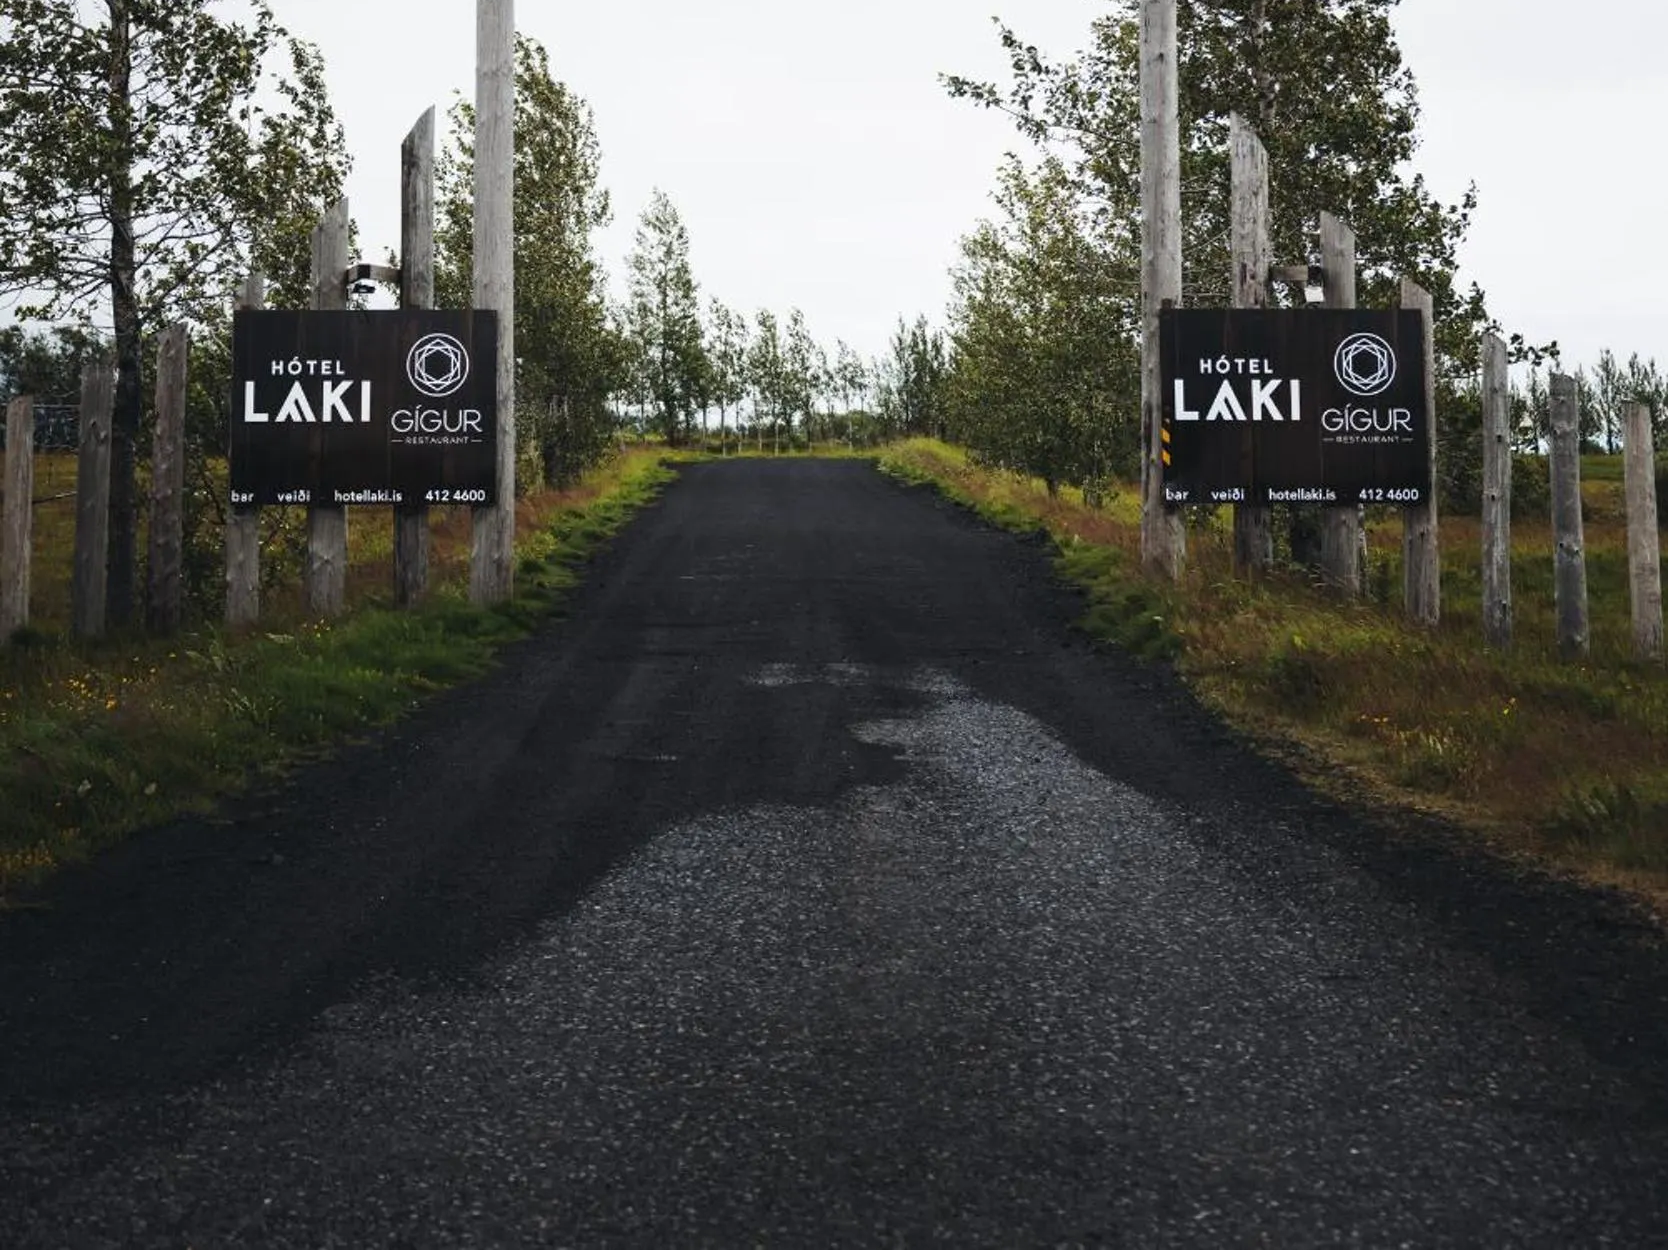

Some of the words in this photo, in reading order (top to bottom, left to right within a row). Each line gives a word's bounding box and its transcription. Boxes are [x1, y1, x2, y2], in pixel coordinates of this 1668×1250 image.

[271, 356, 346, 375] HÓTEL
[1199, 354, 1274, 374] HÓTEL
[244, 380, 371, 423] LAKI
[1174, 379, 1301, 421] LAKI
[391, 404, 483, 433] GÍGUR
[1321, 403, 1413, 432] GÍGUR
[405, 436, 470, 445] RESTAURANT
[1335, 435, 1400, 444] RESTAURANT
[231, 490, 254, 502] bar
[277, 489, 311, 502] veiði
[334, 489, 403, 502] hotellaki.is
[425, 490, 449, 502] 412
[453, 490, 486, 502] 4600
[1165, 488, 1189, 501] bar
[1211, 488, 1245, 501] veiði
[1268, 488, 1337, 501] hotellaki.is
[1359, 489, 1383, 501] 412
[1387, 488, 1419, 501] 4600
